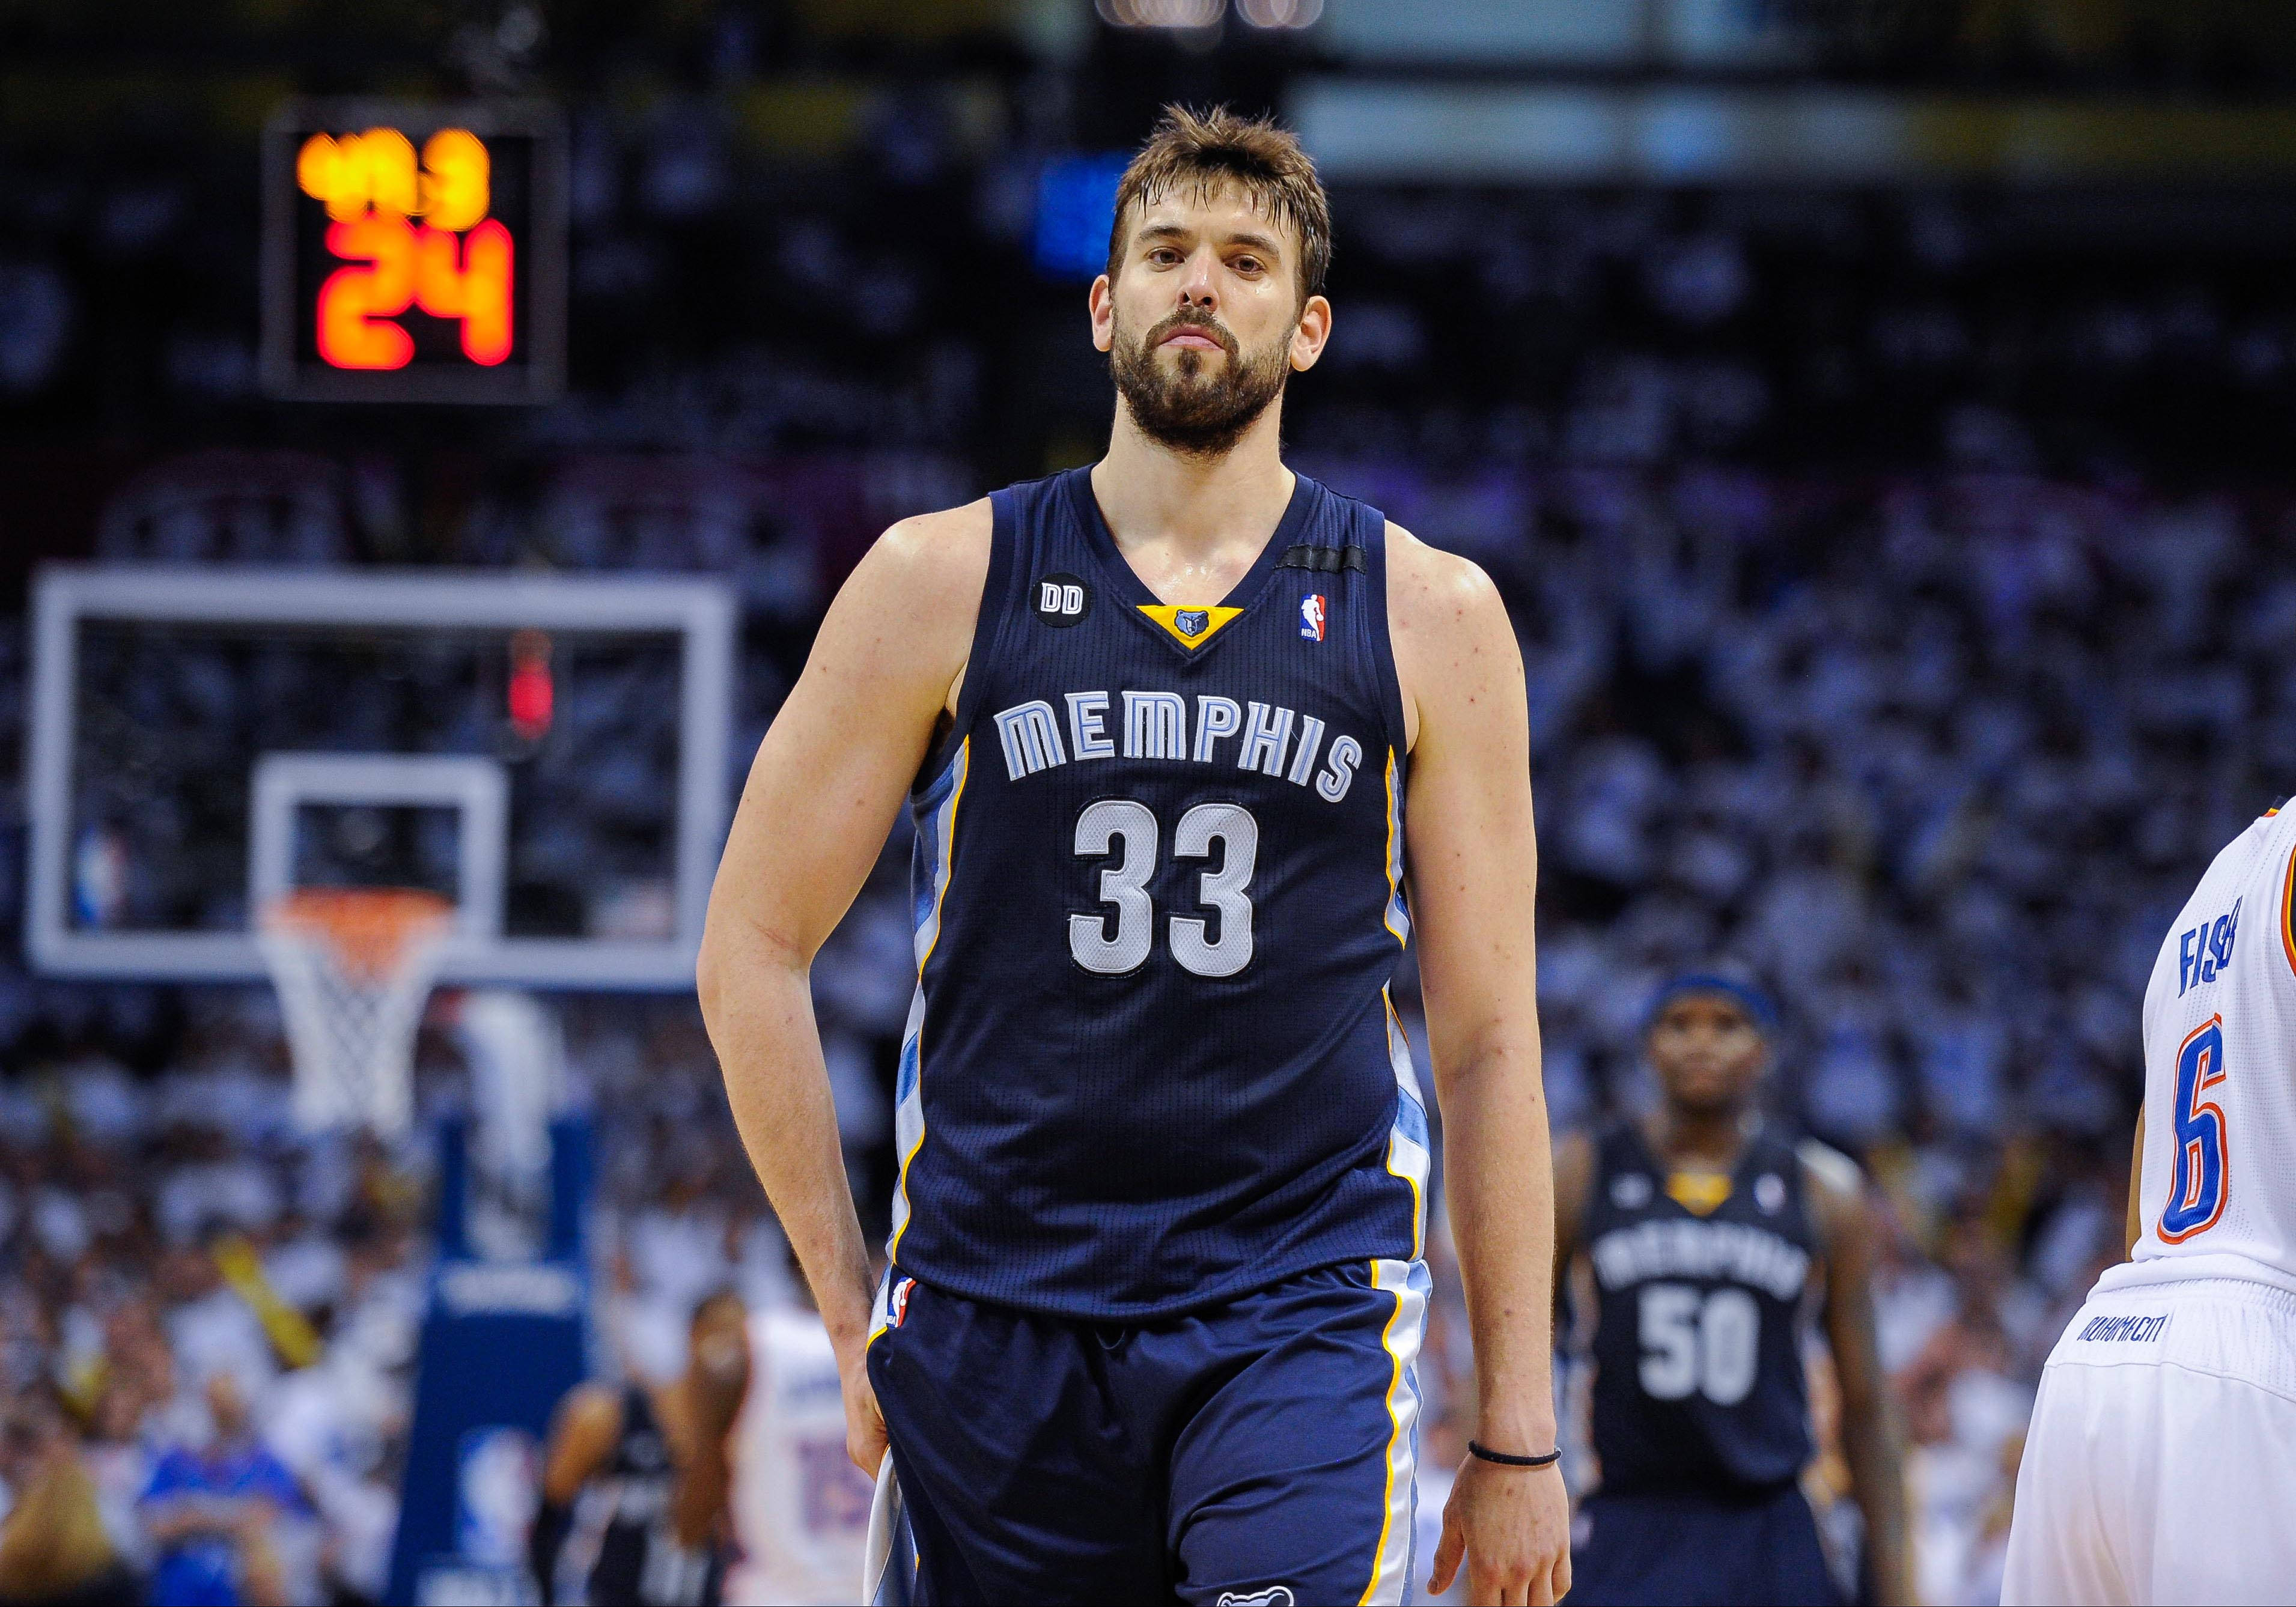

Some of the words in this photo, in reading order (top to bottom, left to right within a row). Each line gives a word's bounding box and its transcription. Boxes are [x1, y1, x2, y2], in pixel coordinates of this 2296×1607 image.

[318, 217, 514, 369] 24
[1040, 582, 1083, 615] DD
[1301, 628, 1317, 639] NBA
[993, 691, 1363, 803] MEMPHIS
[1069, 800, 1258, 977] 33
[2157, 1012, 2229, 1244] 6
[1638, 1283, 1759, 1406] 50
